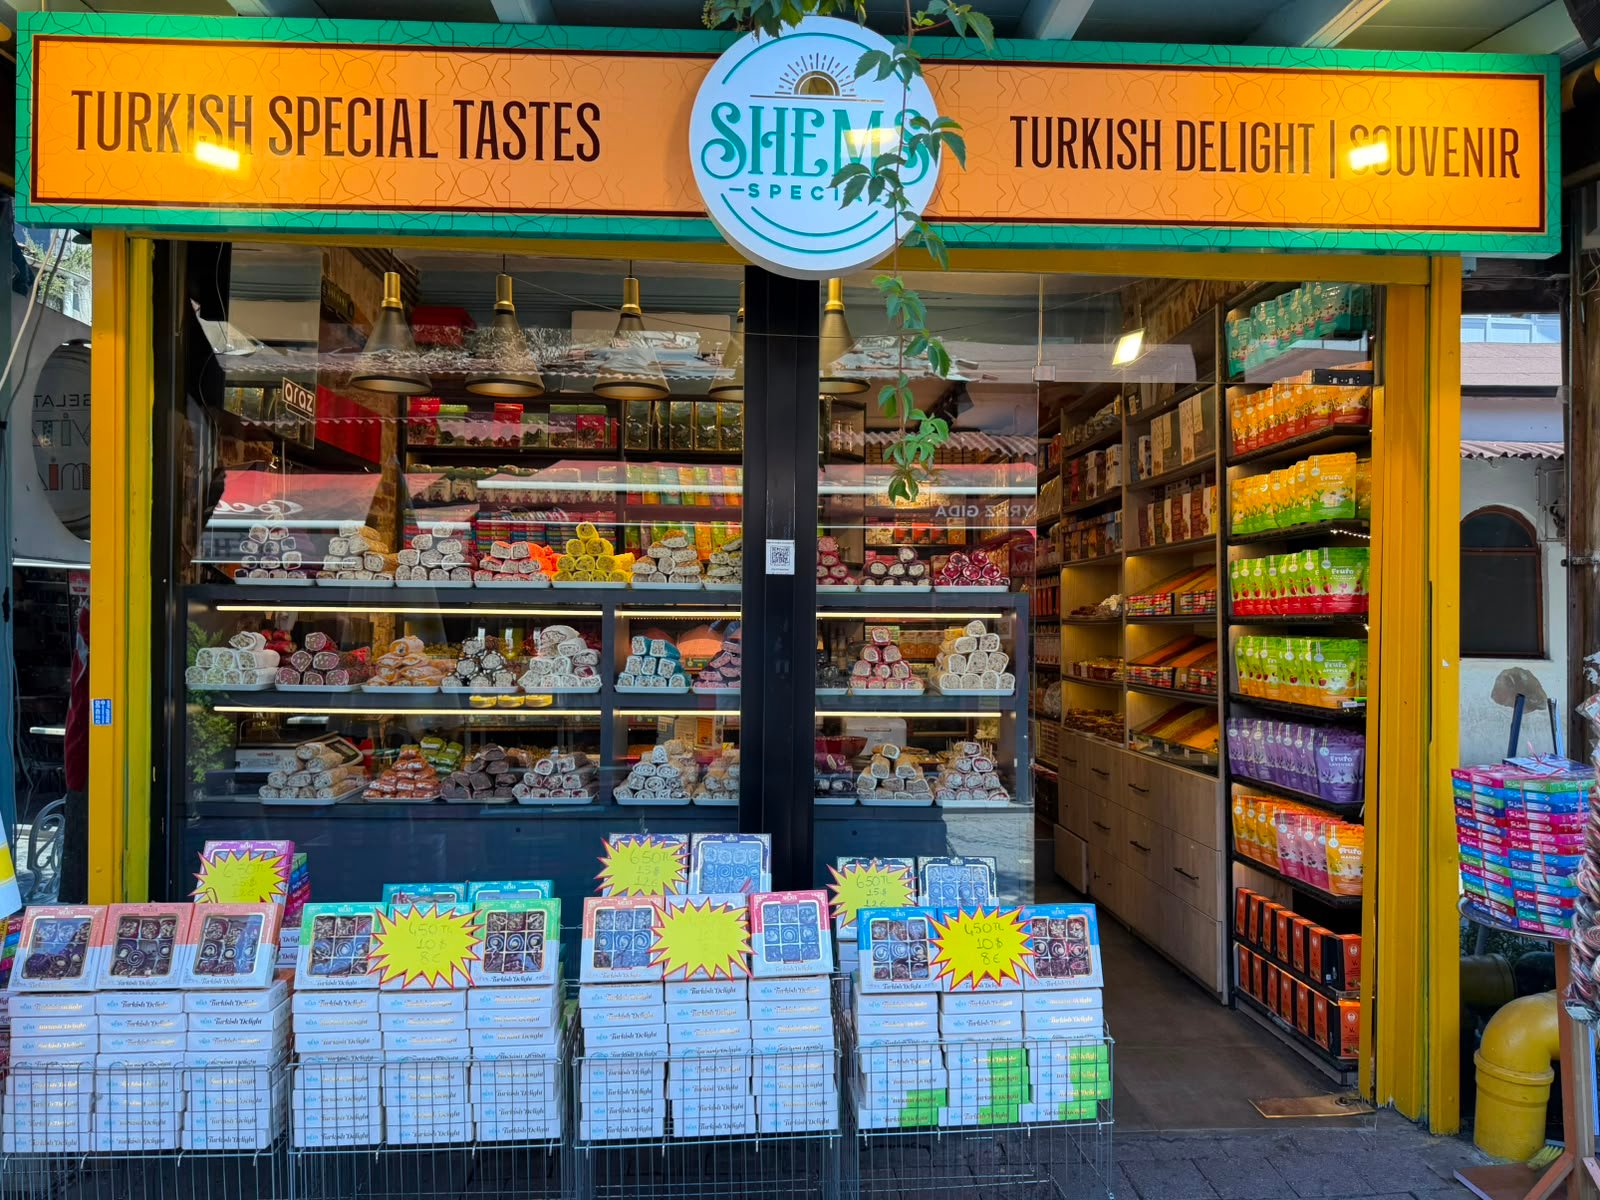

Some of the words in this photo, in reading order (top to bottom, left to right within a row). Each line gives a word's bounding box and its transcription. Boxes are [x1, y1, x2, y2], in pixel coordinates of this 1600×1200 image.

[71, 89, 253, 156] TURKISH
[268, 94, 439, 160] SPECIAL
[453, 98, 601, 162] TASTES
[1009, 114, 1162, 171] TURKISH
[1176, 119, 1316, 175] DELIGHT
[1349, 123, 1521, 179] SOUVENIR
[747, 183, 882, 202] SPECI
[284, 383, 315, 412] araz
